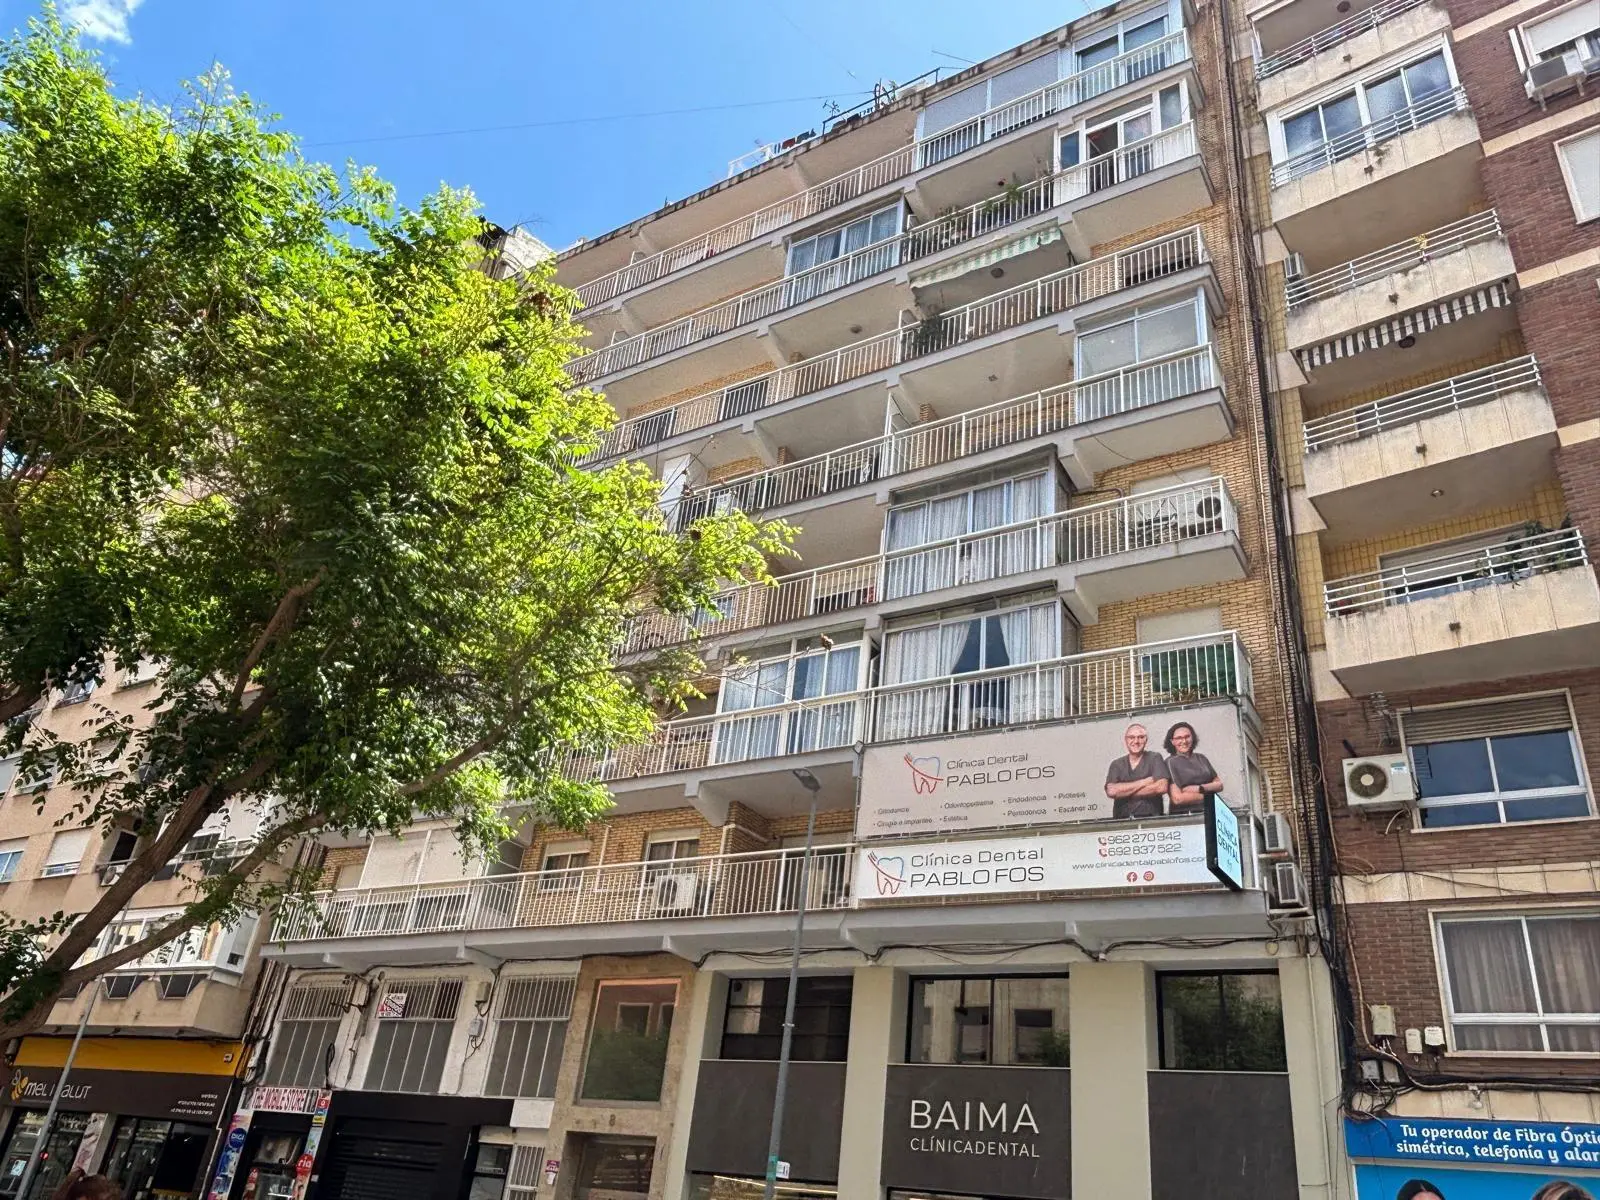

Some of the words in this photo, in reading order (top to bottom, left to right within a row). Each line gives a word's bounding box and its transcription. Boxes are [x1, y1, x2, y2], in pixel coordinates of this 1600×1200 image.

[947, 759, 985, 770] Clínica
[987, 753, 1029, 766] Dental
[946, 769, 1012, 788] PABLO
[1015, 765, 1056, 781] FOS
[1087, 803, 1098, 811] 3D
[1107, 834, 1131, 845] 962
[1132, 832, 1156, 843] 270
[1157, 830, 1181, 841] 942
[911, 852, 972, 867] Clínica
[978, 847, 1044, 863] Dental
[1108, 846, 1132, 857] 692
[1133, 845, 1156, 855] 837
[1157, 843, 1182, 853] 522
[1217, 834, 1240, 864] DENTAL
[910, 869, 990, 888] PABLO
[995, 866, 1044, 883] FOS
[910, 1099, 1040, 1134] BAIMA
[1400, 1124, 1418, 1137] Tu
[1421, 1126, 1489, 1141] operador
[1493, 1127, 1512, 1141] de
[1515, 1128, 1557, 1143] Fibra
[910, 1136, 1040, 1158] CLÍNICADENTAL
[1396, 1139, 1471, 1158] simétrica,
[1473, 1143, 1544, 1161] telefonía
[1548, 1149, 1560, 1164] y
[298, 1156, 312, 1168] ria
